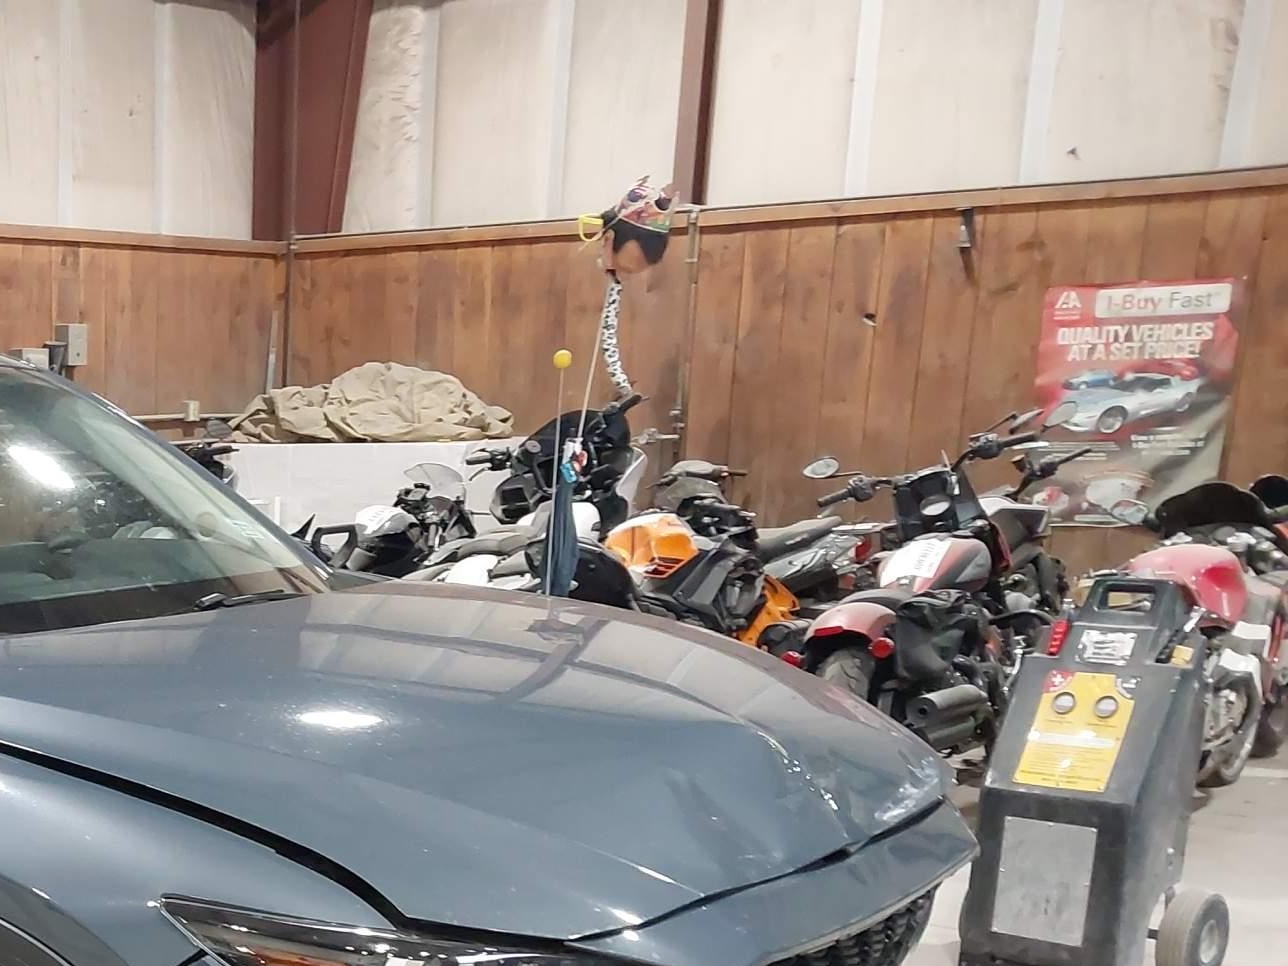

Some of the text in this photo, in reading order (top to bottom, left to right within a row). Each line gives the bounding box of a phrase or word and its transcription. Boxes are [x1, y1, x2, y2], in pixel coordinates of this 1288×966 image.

[1106, 293, 1161, 313] I-Buy
[1056, 321, 1215, 345] QUALITY VEHICLES
[1067, 340, 1202, 362] AT A SET PRICE!
